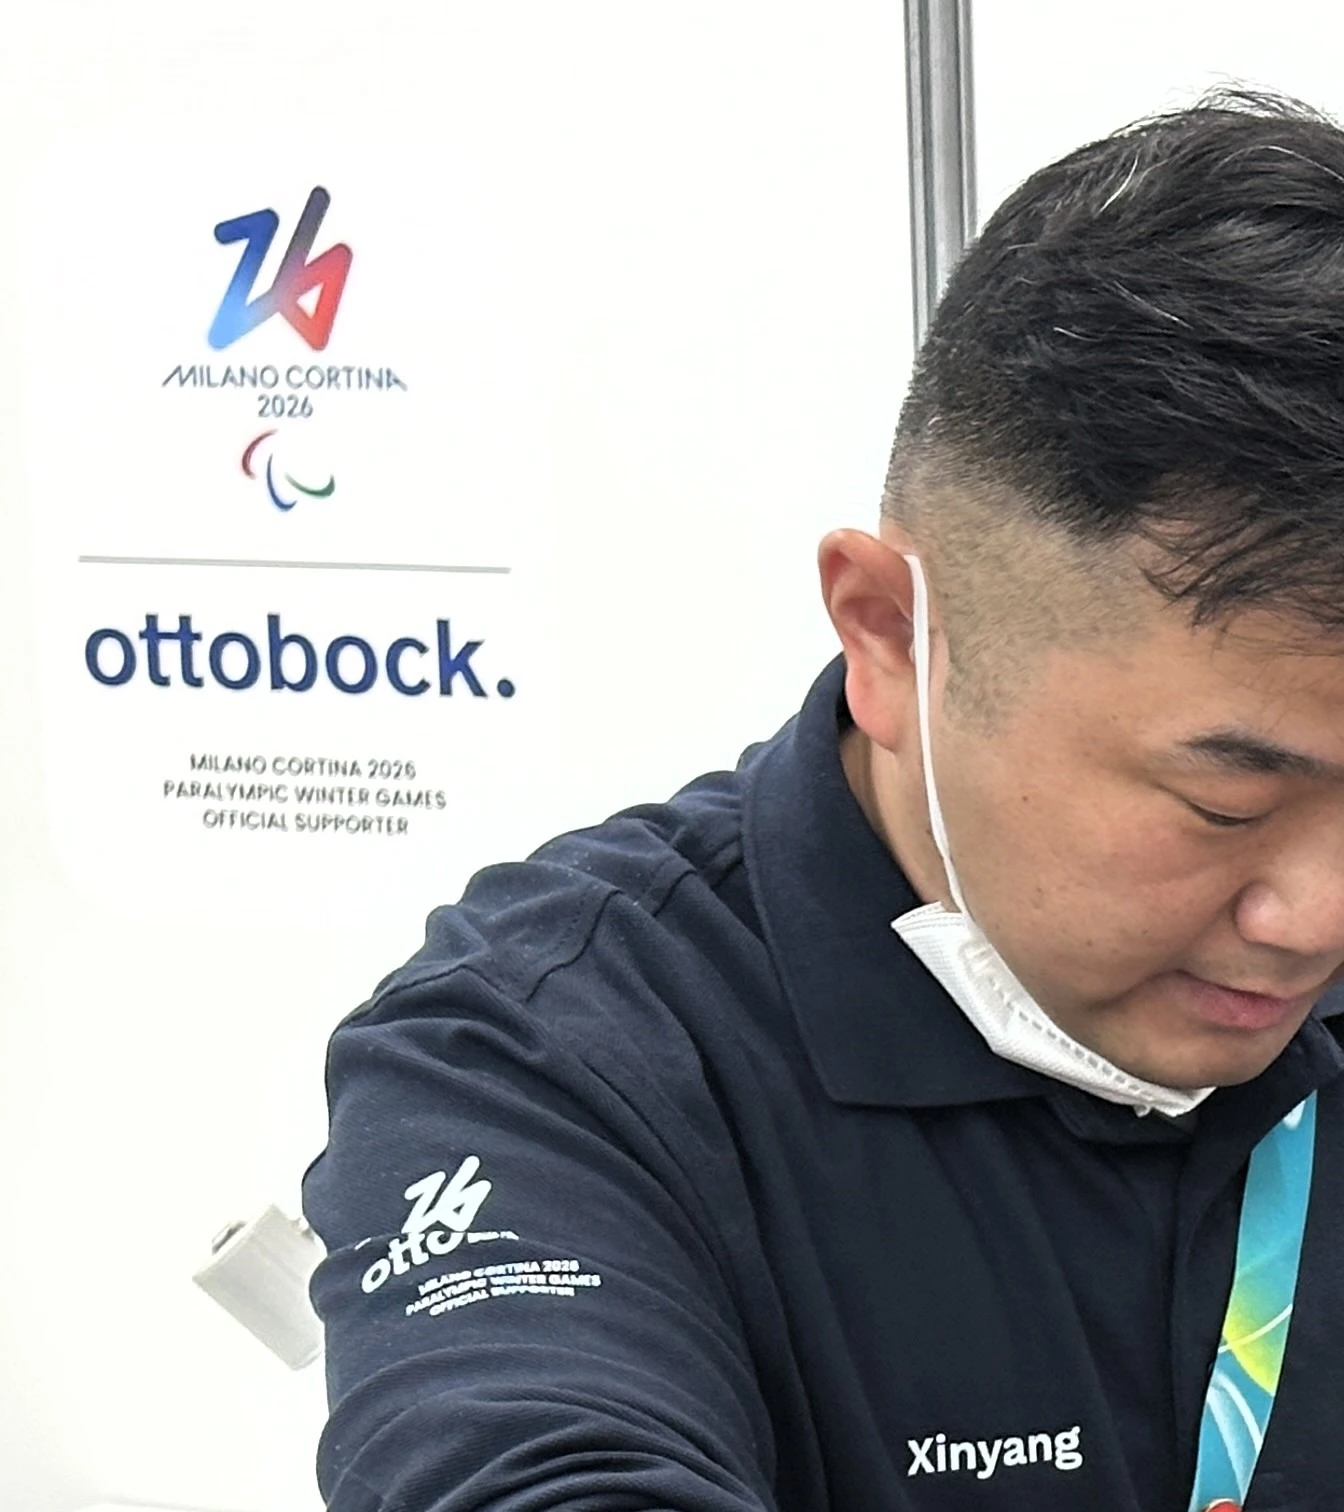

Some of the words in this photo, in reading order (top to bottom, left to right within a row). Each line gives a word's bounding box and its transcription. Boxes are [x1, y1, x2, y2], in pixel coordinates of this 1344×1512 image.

[162, 365, 279, 390] MILANO
[285, 365, 408, 391] CORTINA
[257, 393, 314, 418] 2026
[85, 612, 516, 699] ottobock.
[190, 754, 267, 775] MILANO
[271, 756, 362, 777] CORTINA
[367, 759, 417, 780] 2026
[163, 780, 288, 802] PARALYMPIC
[295, 785, 371, 806] WINTER
[375, 788, 447, 809] GAMES
[203, 809, 288, 831] OFFICIAL
[295, 812, 408, 835] SUPPORTER
[907, 1426, 1084, 1479] Xinyang
